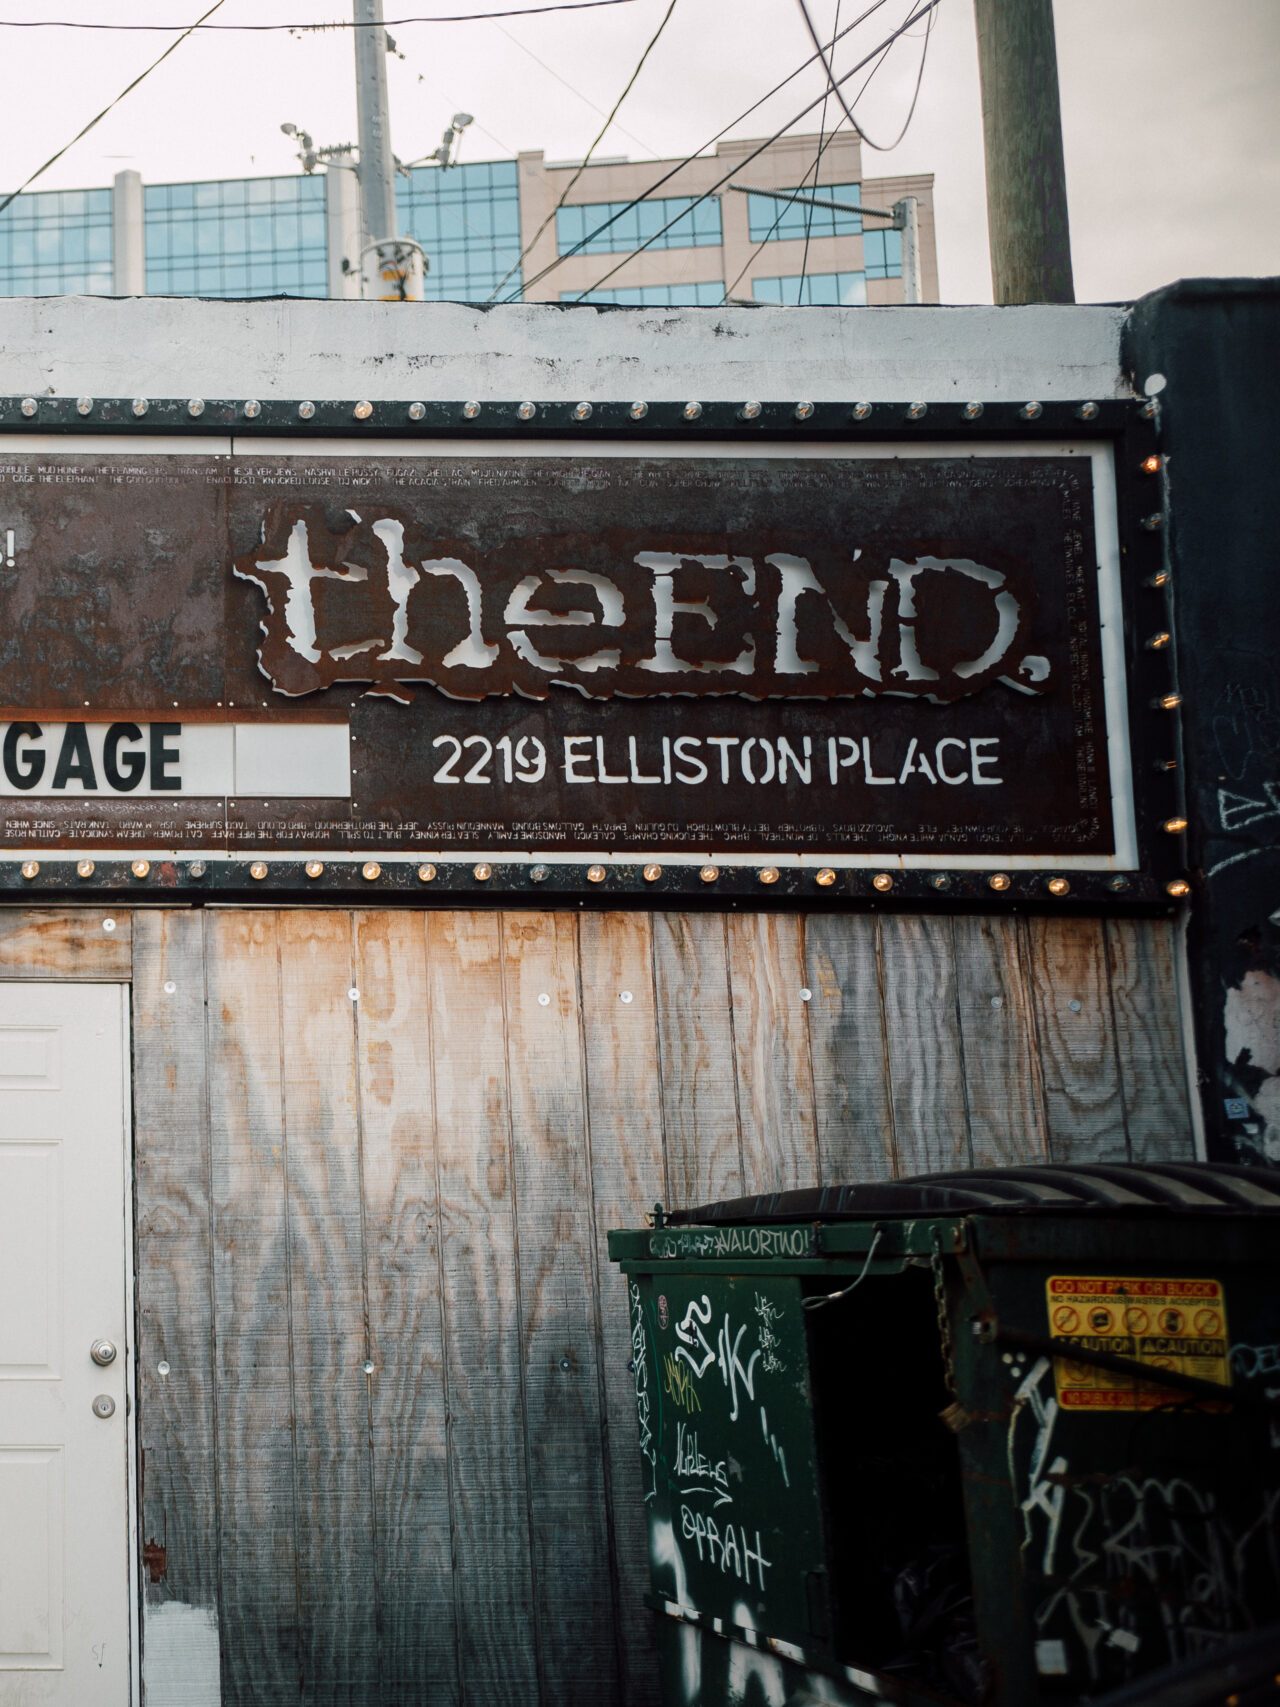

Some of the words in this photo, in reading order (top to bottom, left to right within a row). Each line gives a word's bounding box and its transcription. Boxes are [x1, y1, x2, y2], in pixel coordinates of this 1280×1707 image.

[433, 736, 546, 783] 2219
[562, 736, 811, 784] ELLISTON
[829, 738, 1002, 784] PLACE
